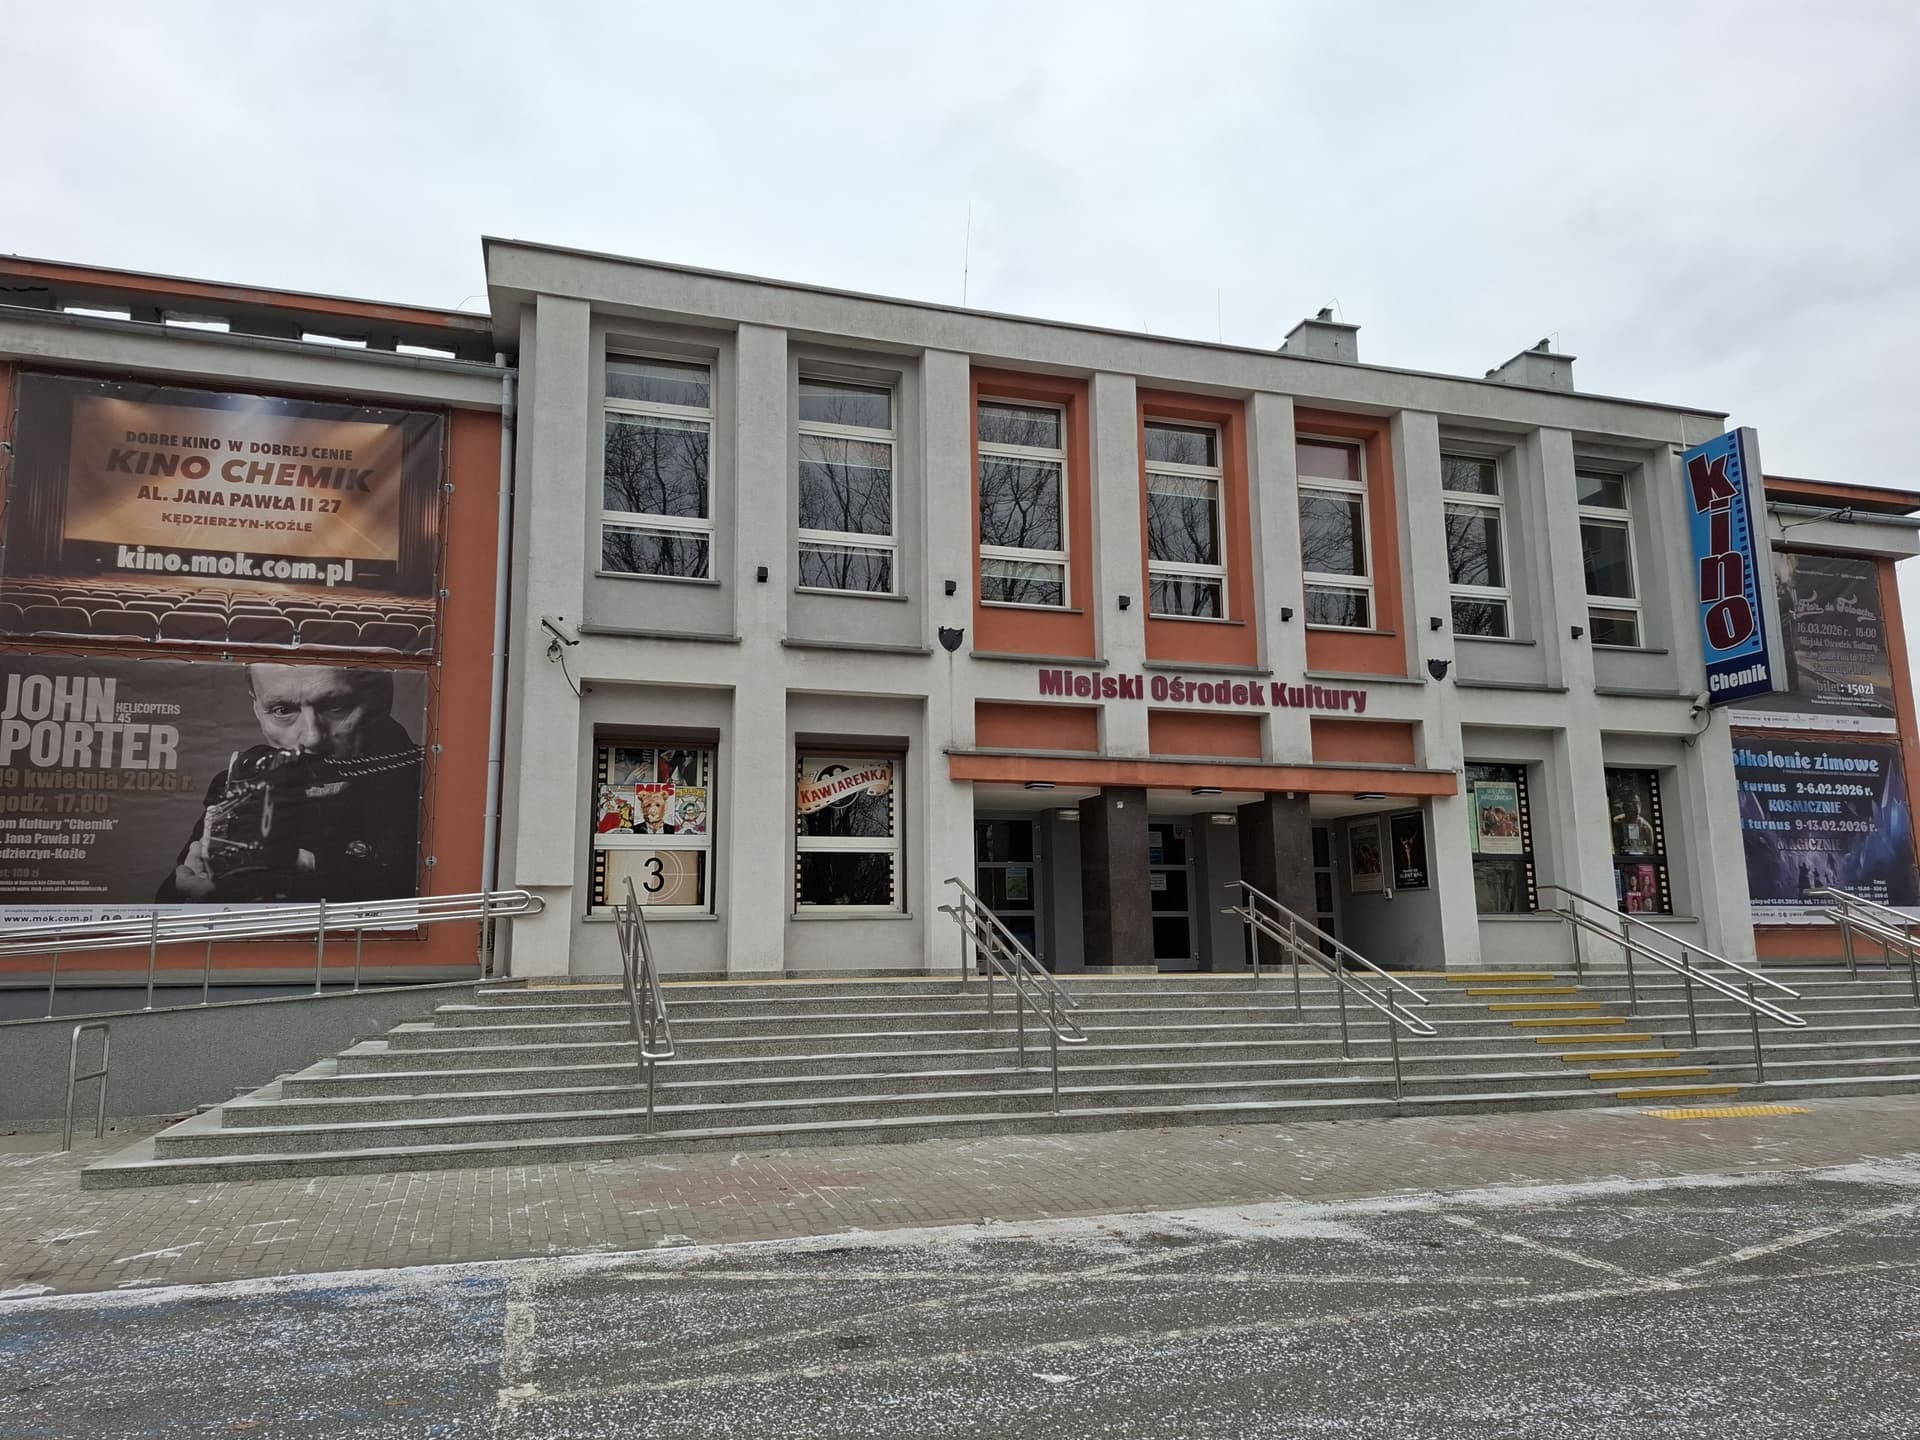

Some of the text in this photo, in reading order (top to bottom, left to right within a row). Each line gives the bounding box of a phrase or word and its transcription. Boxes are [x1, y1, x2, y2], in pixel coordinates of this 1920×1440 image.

[126, 431, 352, 461] DOBRE KINO W DOBREJ CENIE
[104, 448, 376, 493] KINO CHEMIK
[137, 485, 342, 514] AL. JANA PAWŁA II 27
[161, 512, 313, 532] KĘDZIERZYN-KOŹLE
[117, 545, 353, 587] kino.mok.com.pl
[1797, 622, 1842, 636] 16.03.2026
[1855, 627, 1877, 638] 18:00
[1710, 664, 1767, 693] Chemik
[1816, 679, 1874, 695] bilet: 150zł
[1, 674, 117, 722] JOHN
[1038, 669, 1367, 713] Miejski Ośrodek Kultury
[116, 702, 181, 715] HELICOPTERS
[0, 719, 179, 770] PORTER
[1814, 752, 1880, 772] zimowe
[24, 768, 119, 789] kwietnia
[123, 771, 177, 791] 2026
[800, 769, 887, 804] KAWIARENKA
[1744, 781, 1786, 793] turnus
[1796, 782, 1864, 796] 2-6.02.2026
[55, 793, 109, 813] 17.00
[1768, 799, 1842, 814] KOSMICZNIE
[19, 818, 62, 830] Kultury
[1748, 819, 1791, 831] turnus
[1795, 819, 1868, 832] 9-13.02.2026
[4, 833, 32, 844] Jana
[34, 833, 70, 844] Pawła
[82, 833, 96, 844] 27
[1777, 838, 1842, 851] MAGICZNIE
[643, 857, 665, 893] 3
